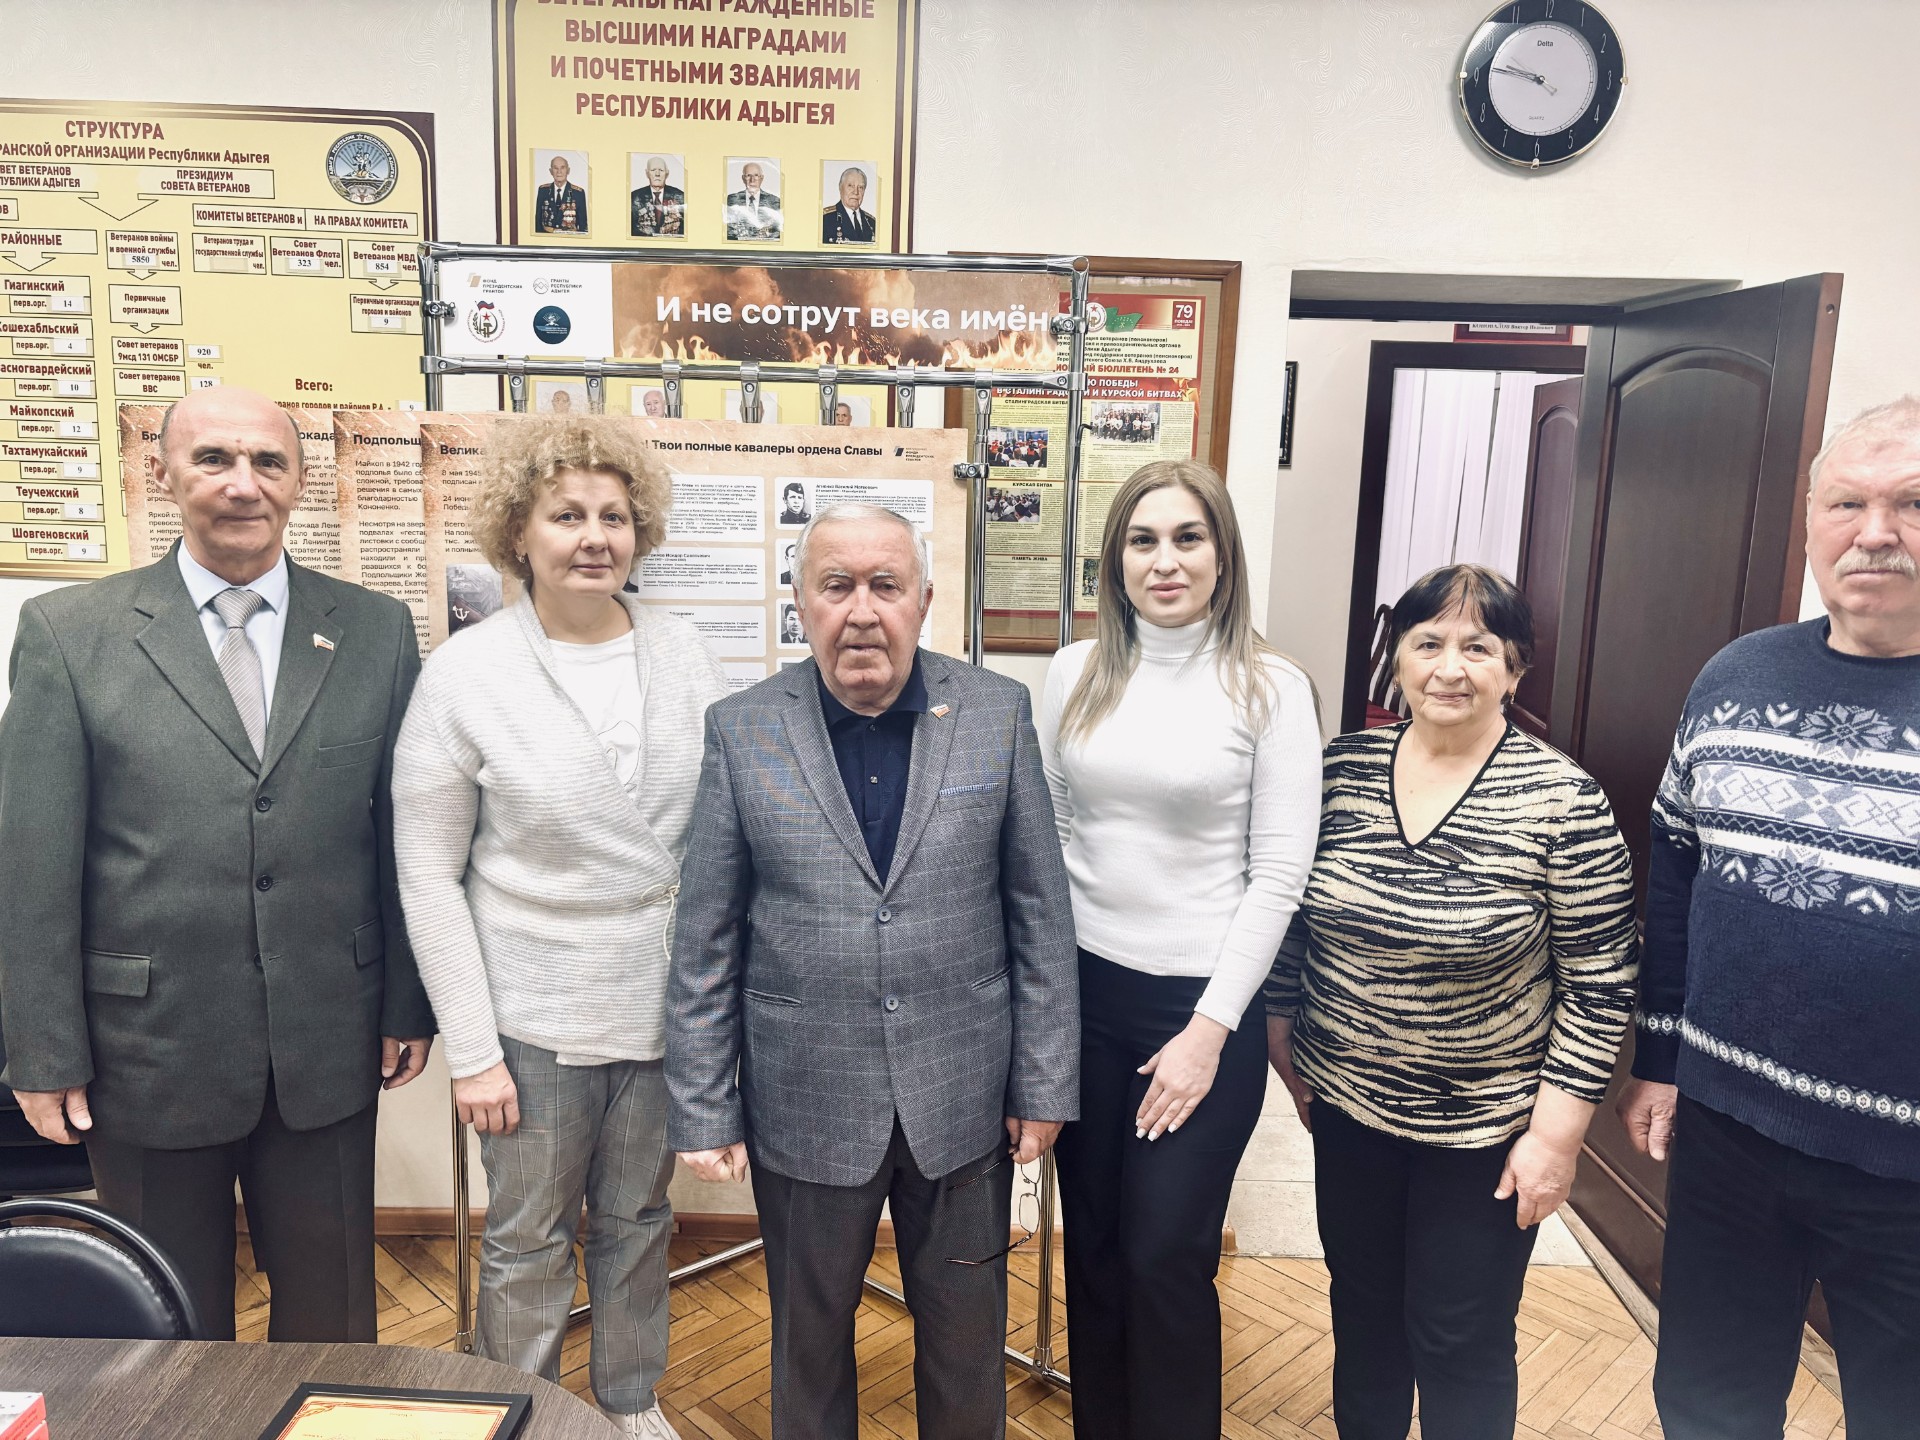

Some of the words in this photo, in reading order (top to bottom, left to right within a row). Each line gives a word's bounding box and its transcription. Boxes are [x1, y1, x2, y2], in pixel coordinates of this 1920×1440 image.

[566, 19, 694, 47] ВЫСШИМИ
[702, 25, 846, 56] НАГРАДАМИ
[550, 56, 566, 78] И
[574, 56, 724, 84] ПОЧЕТНЫМИ
[730, 64, 860, 90] ЗВАНИЯМИ
[576, 92, 731, 120] РЕСПУБЛИКИ
[737, 99, 835, 126] АДЫГЕЯ
[66, 120, 164, 140] СТРУКТУРА
[55, 144, 146, 161] ОРГАНИЗАЦИИ
[148, 147, 220, 163] Республики
[224, 150, 270, 164] Адыгея
[19, 166, 71, 176] ВЕТЕРАНОВ
[177, 170, 233, 181] ПРЕЗИДИУМ
[43, 178, 80, 188] АДЫГЕЯ
[160, 181, 195, 192] СОВЕТА
[197, 182, 250, 193] ВЕТЕРАНОВ
[196, 210, 244, 222] КОМИТЕТЫ
[246, 212, 295, 224] ВЕТЕРАНОВ
[314, 215, 326, 225] НА
[328, 216, 362, 227] ПРАВАХ
[364, 218, 408, 229] КОМИТЕТА
[1, 232, 62, 246] РАЙОННЫЕ
[110, 233, 149, 242] Ветеранов
[150, 234, 174, 242] войны
[204, 236, 233, 246] Ветеранов
[294, 240, 317, 248] Совет
[372, 243, 395, 252] Совет
[116, 246, 146, 254] военной
[148, 246, 176, 256] службы
[272, 248, 314, 257] Ветеранов
[316, 250, 341, 259] Флота
[132, 255, 150, 264] 5850
[353, 252, 396, 260] Ветеранов
[397, 253, 416, 263] МВД
[297, 259, 312, 267] 323
[324, 260, 341, 268] чел.
[376, 262, 389, 271] 854
[4, 279, 65, 292] Гиагинский
[124, 293, 166, 303] Первичные
[14, 299, 47, 308] перв.орг.
[64, 300, 72, 308] 14
[122, 306, 169, 315] организации
[656, 296, 680, 322] И
[691, 303, 731, 323] не
[742, 303, 860, 332] сотрут
[870, 307, 950, 329] века
[961, 304, 1048, 331] имён
[1176, 305, 1193, 318] 79
[383, 318, 389, 326] 9
[16, 341, 49, 350] перв.орг.
[117, 340, 139, 349] Совет
[140, 342, 178, 350] ветеранов
[197, 348, 211, 356] 920
[118, 353, 136, 363] 9мсд
[152, 354, 178, 362] ОМСБР
[1098, 365, 1154, 373] БЮЛЛЕТЕНЬ
[119, 371, 140, 380] Совет
[142, 373, 181, 382] ветеранов
[18, 383, 52, 391] перв.орг.
[200, 380, 213, 388] 128
[295, 378, 333, 392] Всего:
[1099, 379, 1138, 388] ПОБЕДЫ
[143, 385, 158, 393] ВВС
[1101, 388, 1144, 397] КУРСКОЙ
[10, 405, 74, 418] Майкопский
[21, 424, 55, 433] перв.орг.
[72, 425, 81, 433] 12
[353, 434, 421, 446] Подпольщ
[2, 444, 88, 459] Тахтамукайский
[652, 440, 682, 450] Твои
[685, 442, 732, 452] полные
[734, 444, 794, 456] кавалеры
[798, 446, 841, 457] ордена
[844, 445, 882, 456] Славы
[24, 466, 57, 474] перв.орг.
[16, 486, 79, 499] Теучежский
[27, 507, 60, 516] перв.орг.
[12, 528, 89, 540] Шовгеновский
[30, 548, 63, 556] перв.орг.
